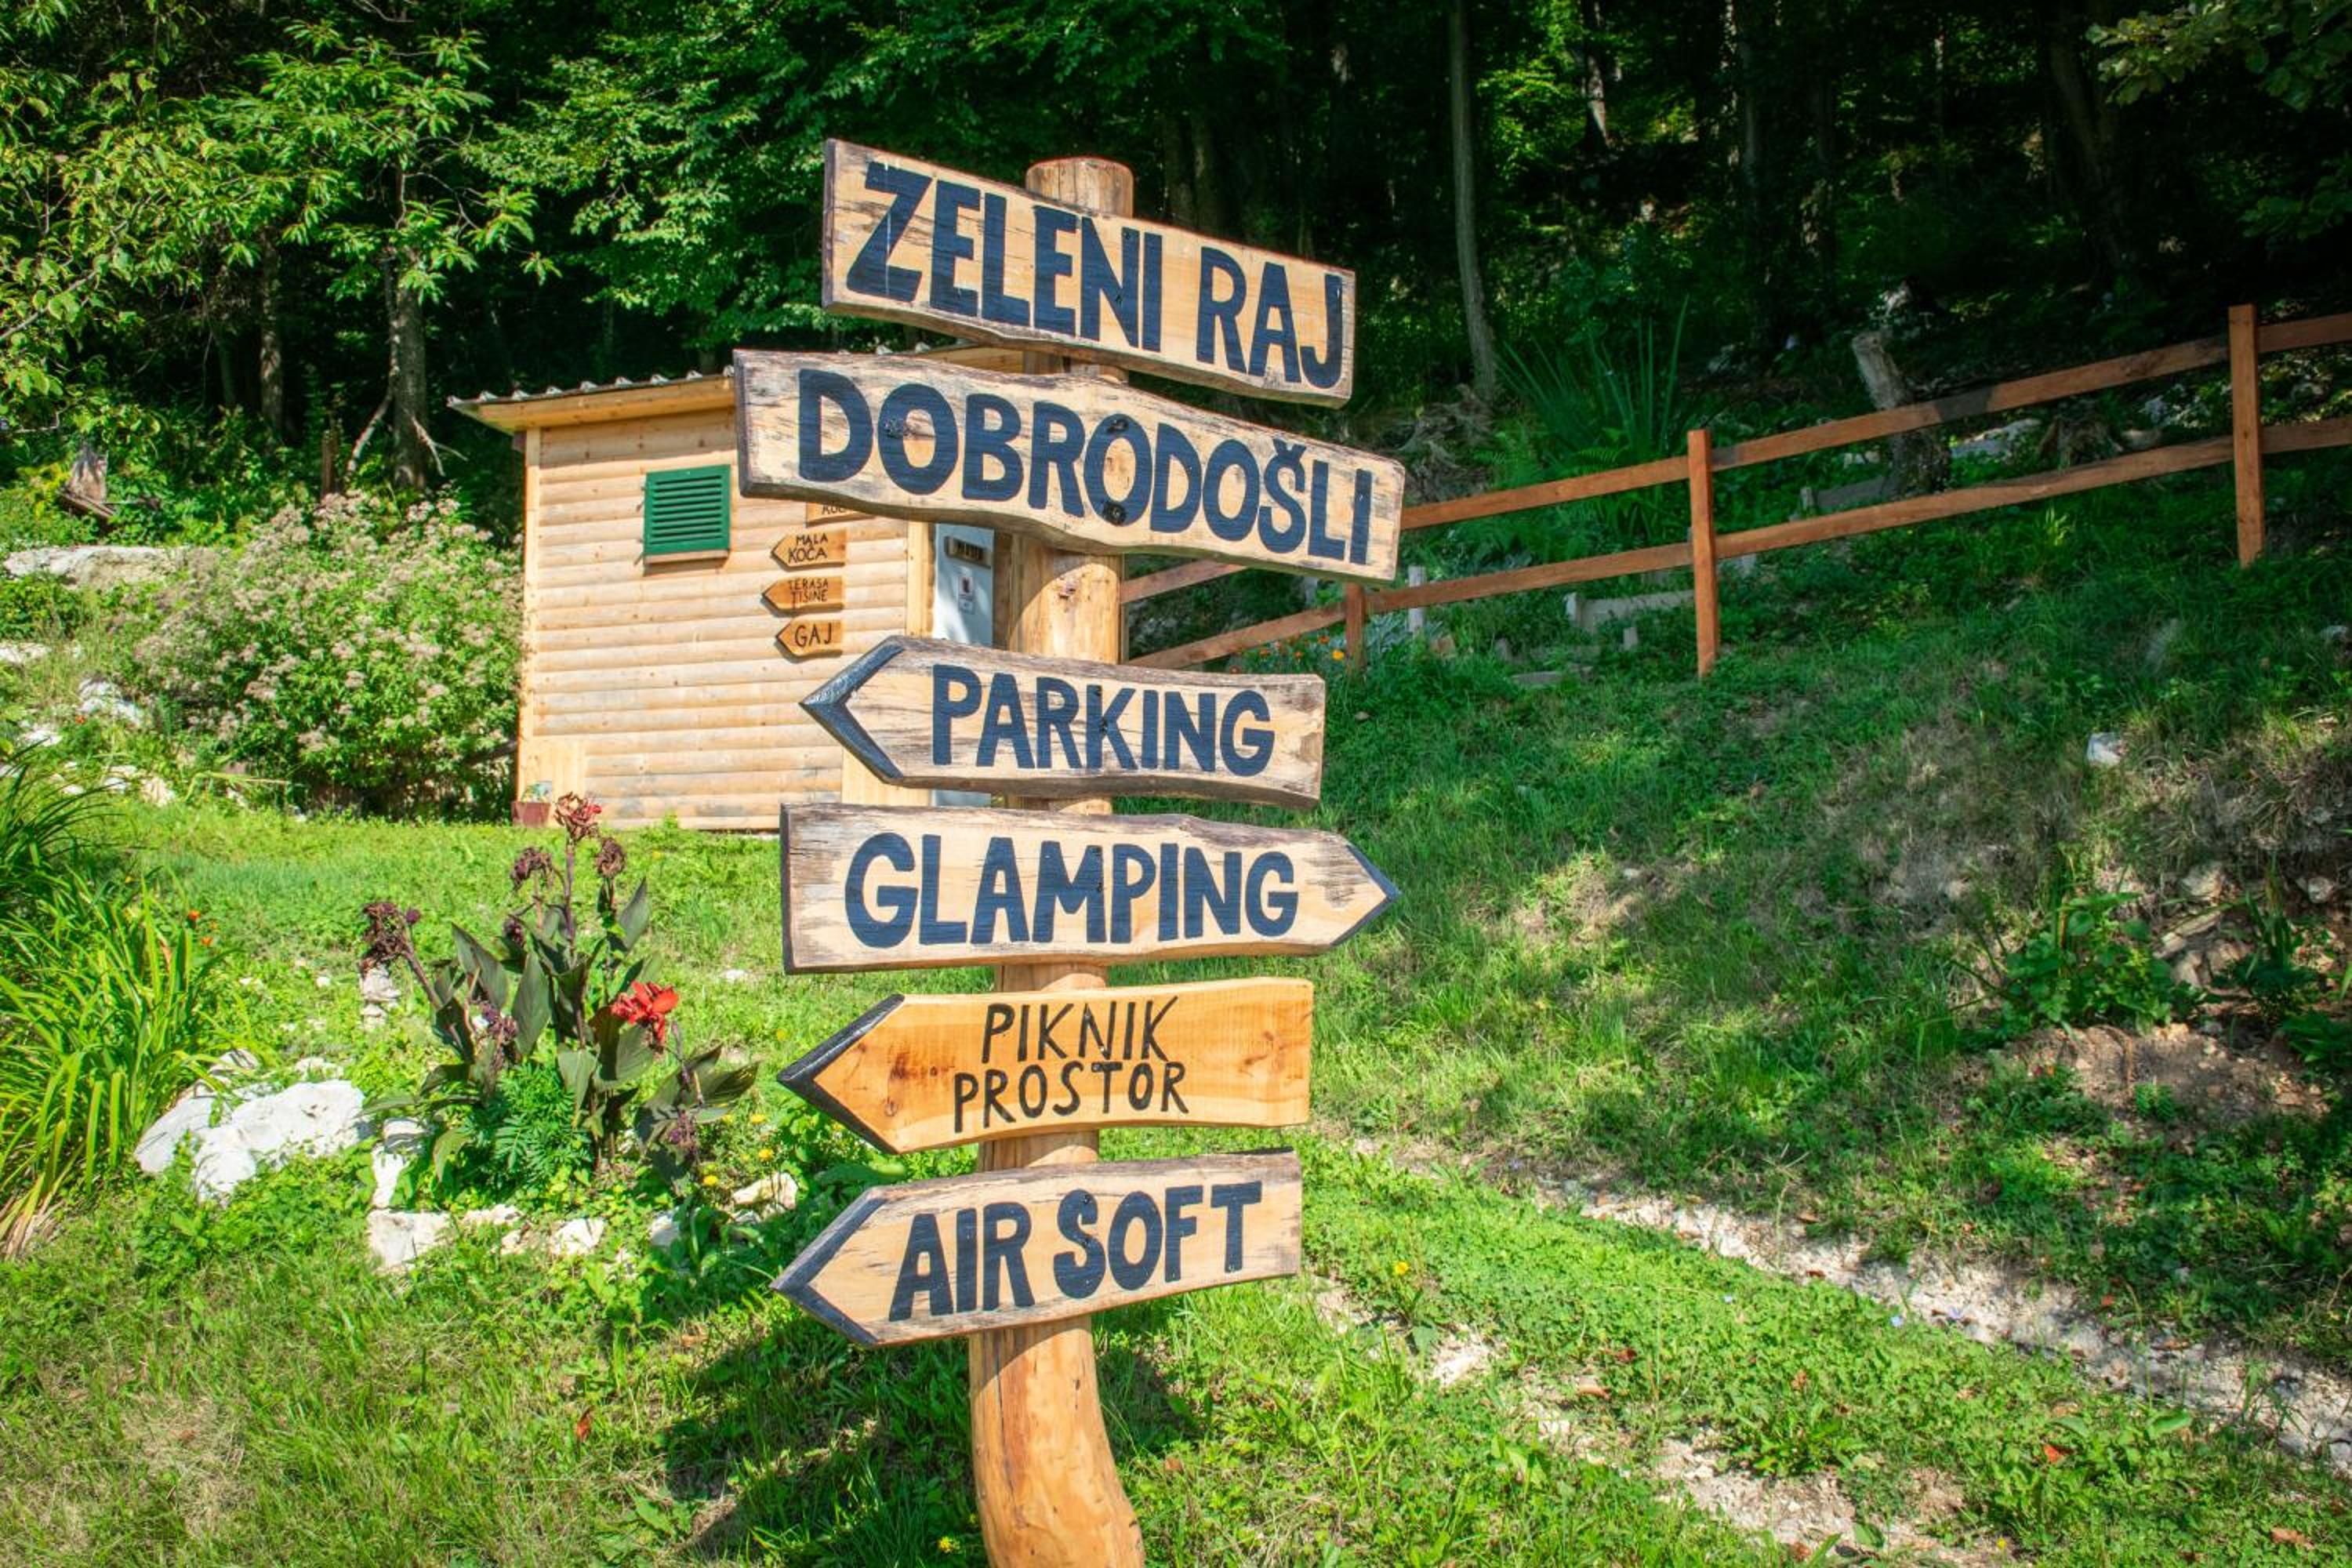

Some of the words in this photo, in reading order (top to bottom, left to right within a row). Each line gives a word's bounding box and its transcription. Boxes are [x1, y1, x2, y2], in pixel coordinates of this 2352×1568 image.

[847, 162, 1162, 352] ZELENI
[1196, 247, 1343, 387] RAJ
[798, 368, 1372, 564] DOBRODOŠLI
[789, 578, 829, 590] TERASA
[796, 532, 829, 545] MALA
[794, 622, 832, 648] GAJ
[932, 664, 1276, 777] PARKING
[845, 833, 1298, 948] GLAMPING
[982, 996, 1179, 1063] PIKNIK
[953, 1061, 1189, 1134] PROSTOR
[889, 1203, 1036, 1322] AIR
[1054, 1181, 1262, 1299] SOFT
